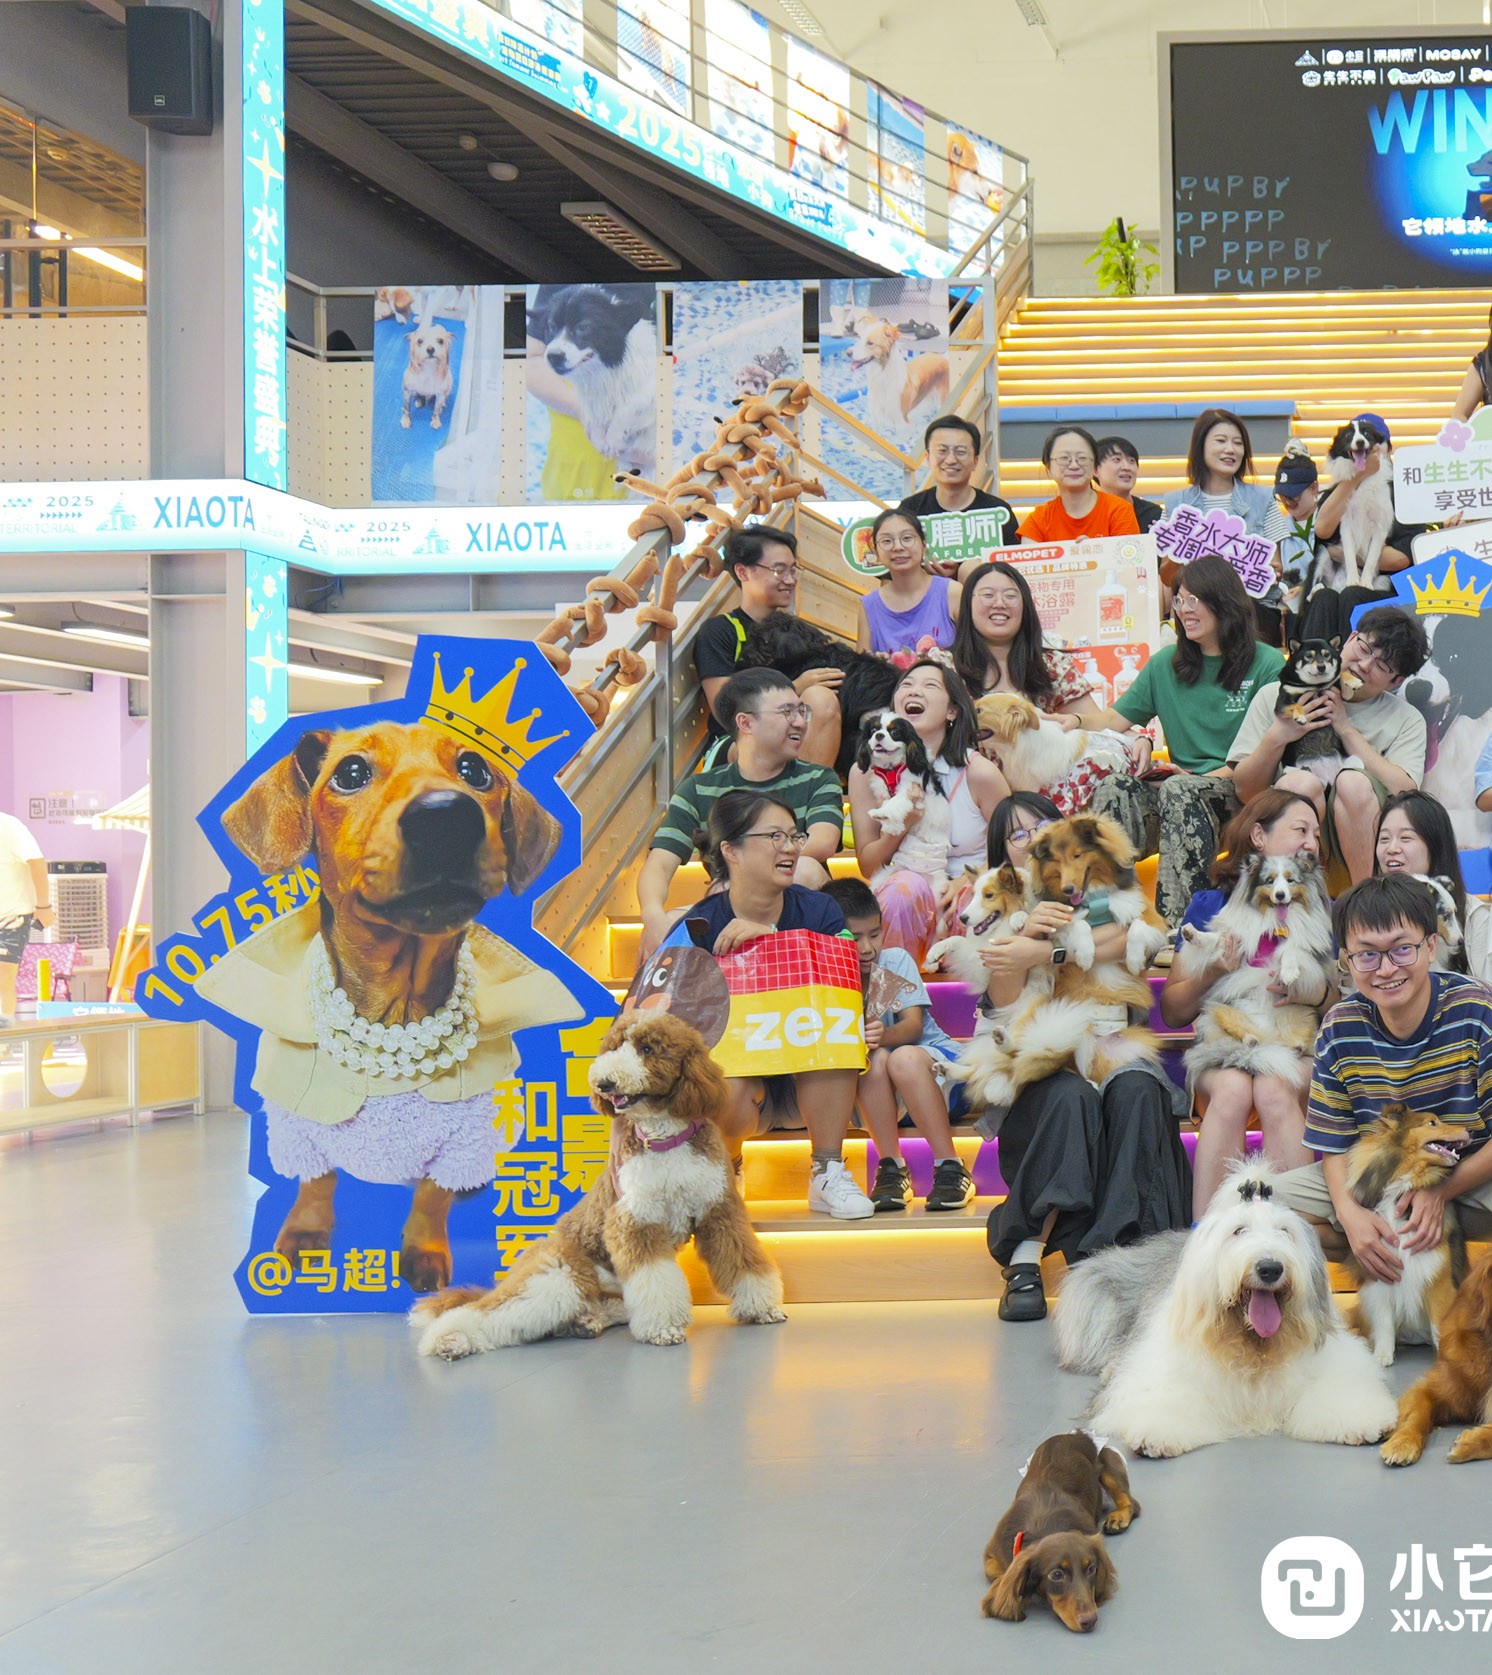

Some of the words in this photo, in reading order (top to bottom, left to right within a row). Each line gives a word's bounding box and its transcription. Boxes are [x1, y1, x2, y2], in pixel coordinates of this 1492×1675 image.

[1425, 48, 1482, 61] MOSAY
[614, 97, 702, 168] 2025
[46, 495, 95, 507] 2025
[153, 495, 256, 532] XIAOTA
[366, 520, 412, 533] 2025
[465, 521, 568, 553] XIAOTA
[922, 514, 997, 549] 膳师
[1173, 509, 1271, 567] 香水大师
[995, 548, 1058, 562] ELMOPET
[143, 864, 322, 1008] 10.75秒
[744, 1003, 868, 1052] zez
[247, 1247, 401, 1297] @马超!
